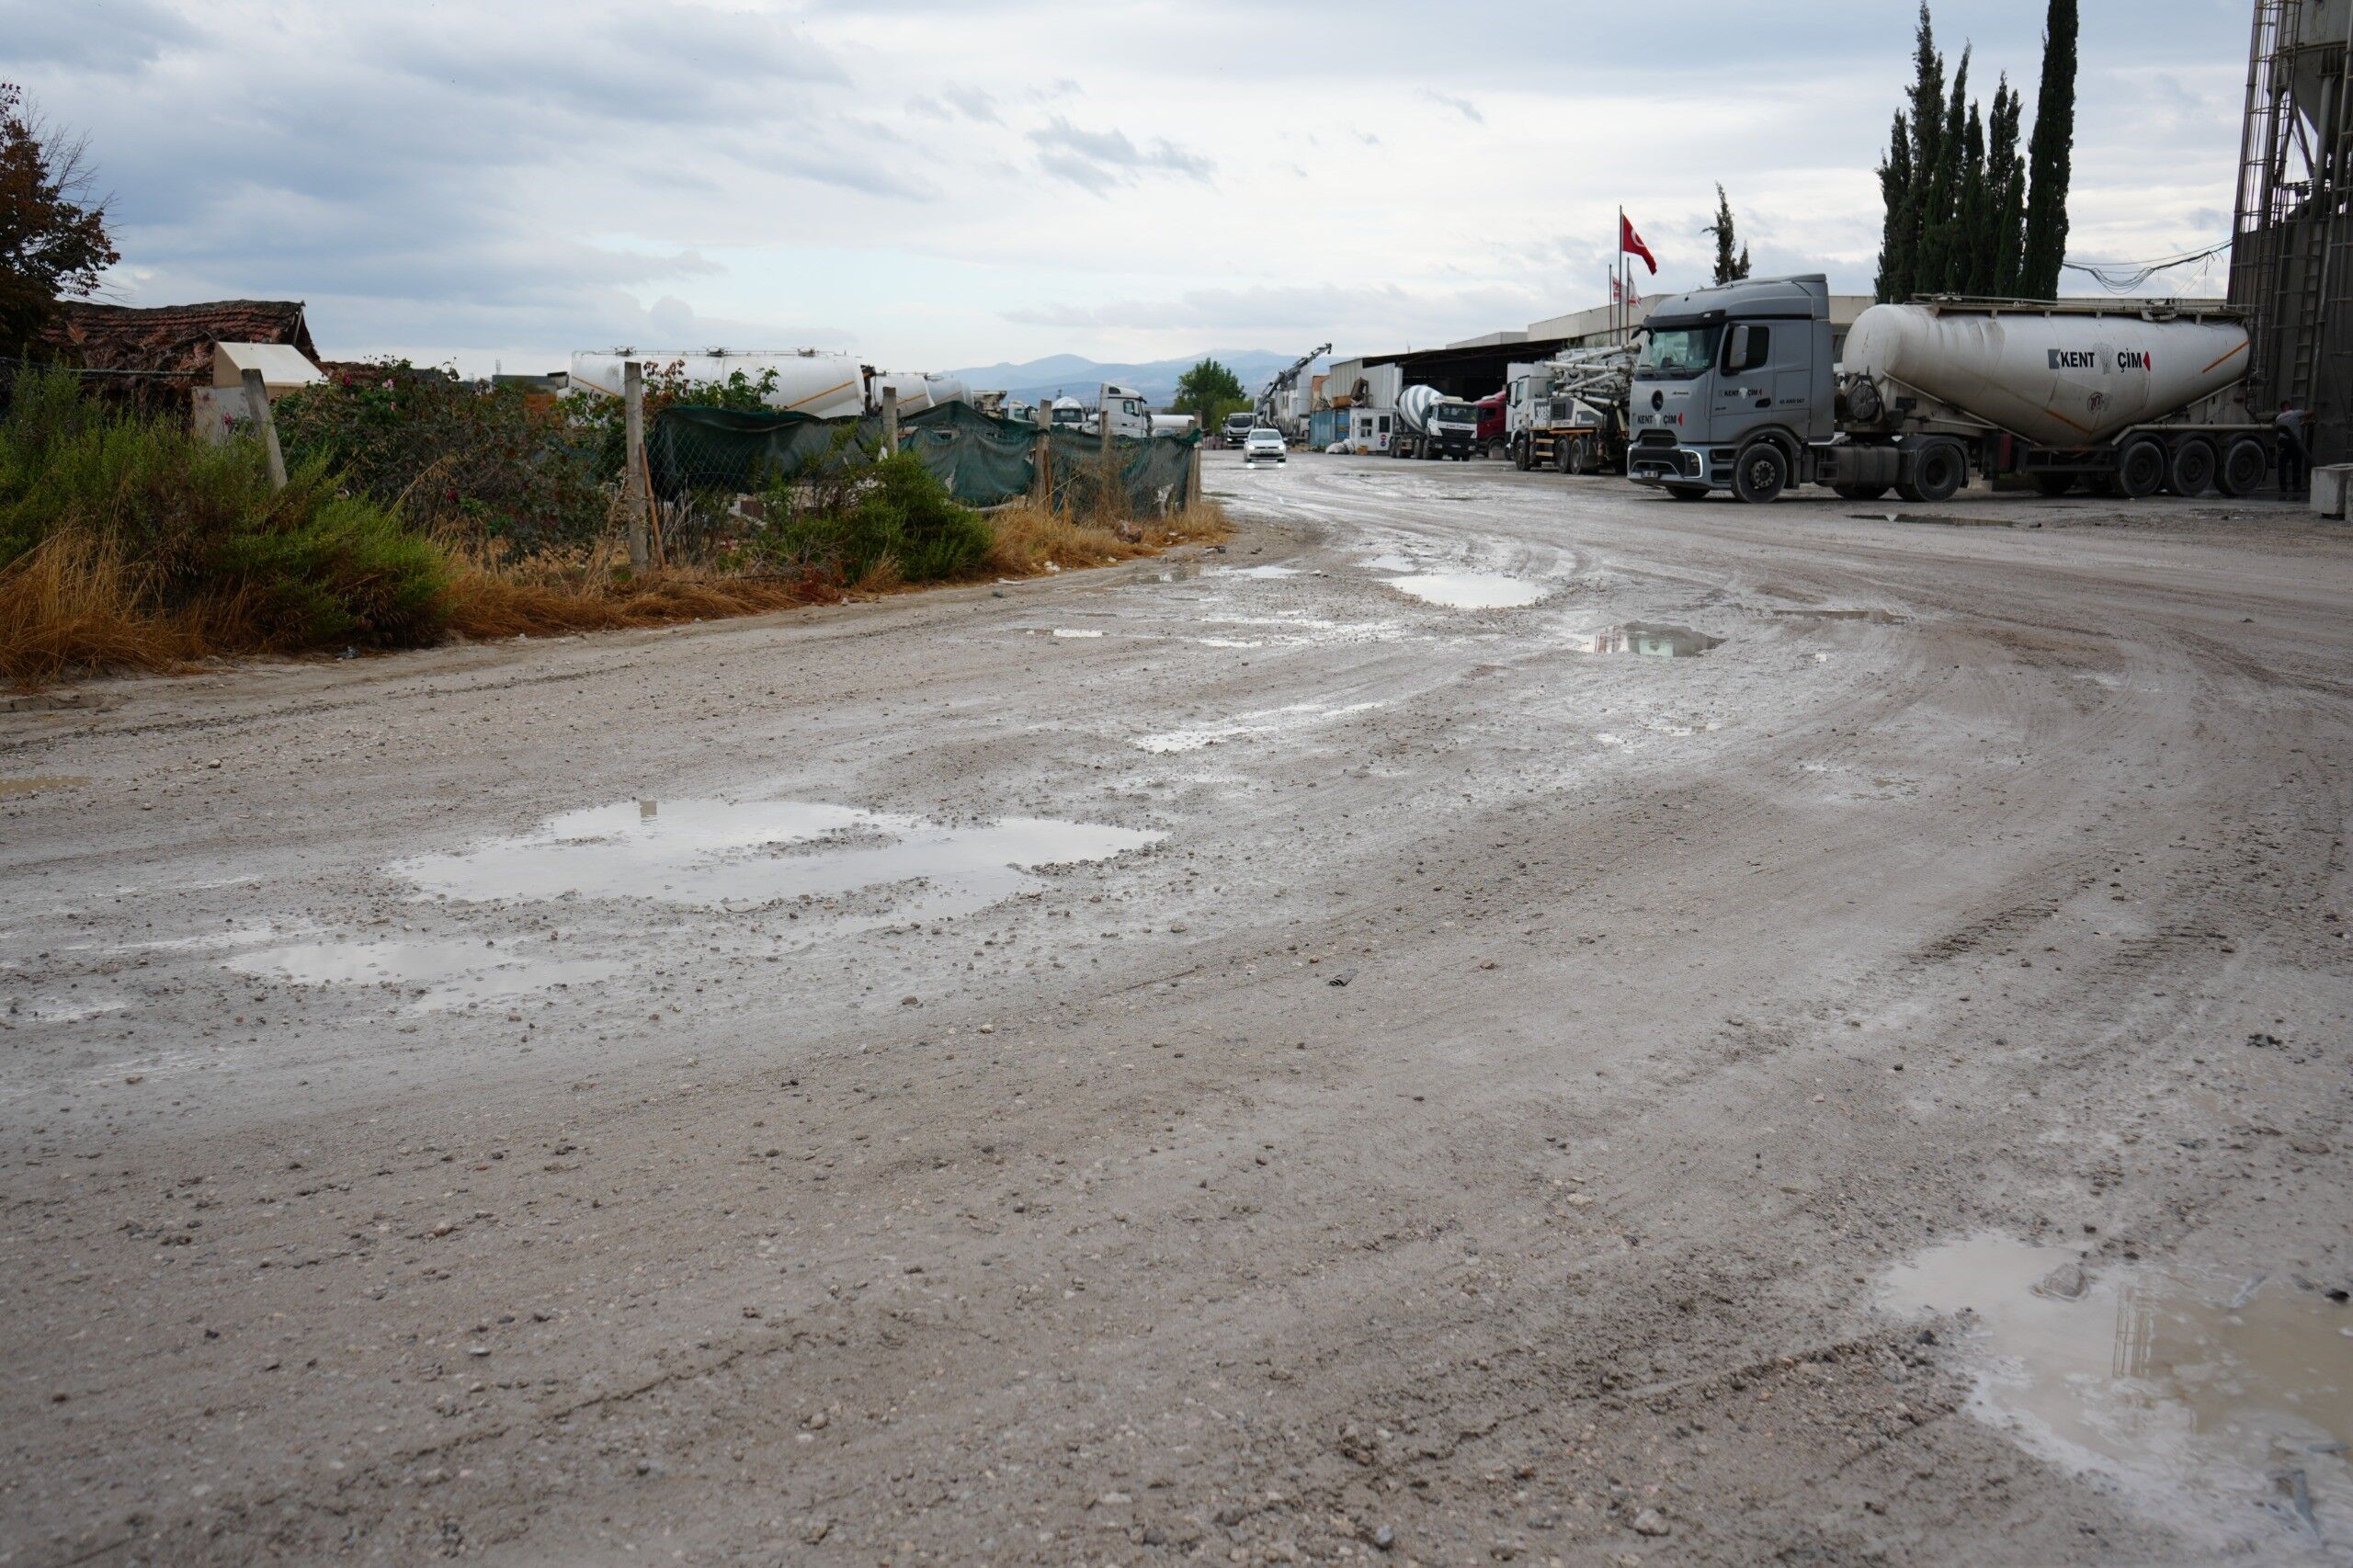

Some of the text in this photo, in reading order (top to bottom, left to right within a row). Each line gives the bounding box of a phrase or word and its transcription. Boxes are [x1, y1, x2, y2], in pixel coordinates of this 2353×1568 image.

[2060, 347, 2143, 373] KENT ÇİM
[1637, 413, 1677, 426] KENT ÇİM
